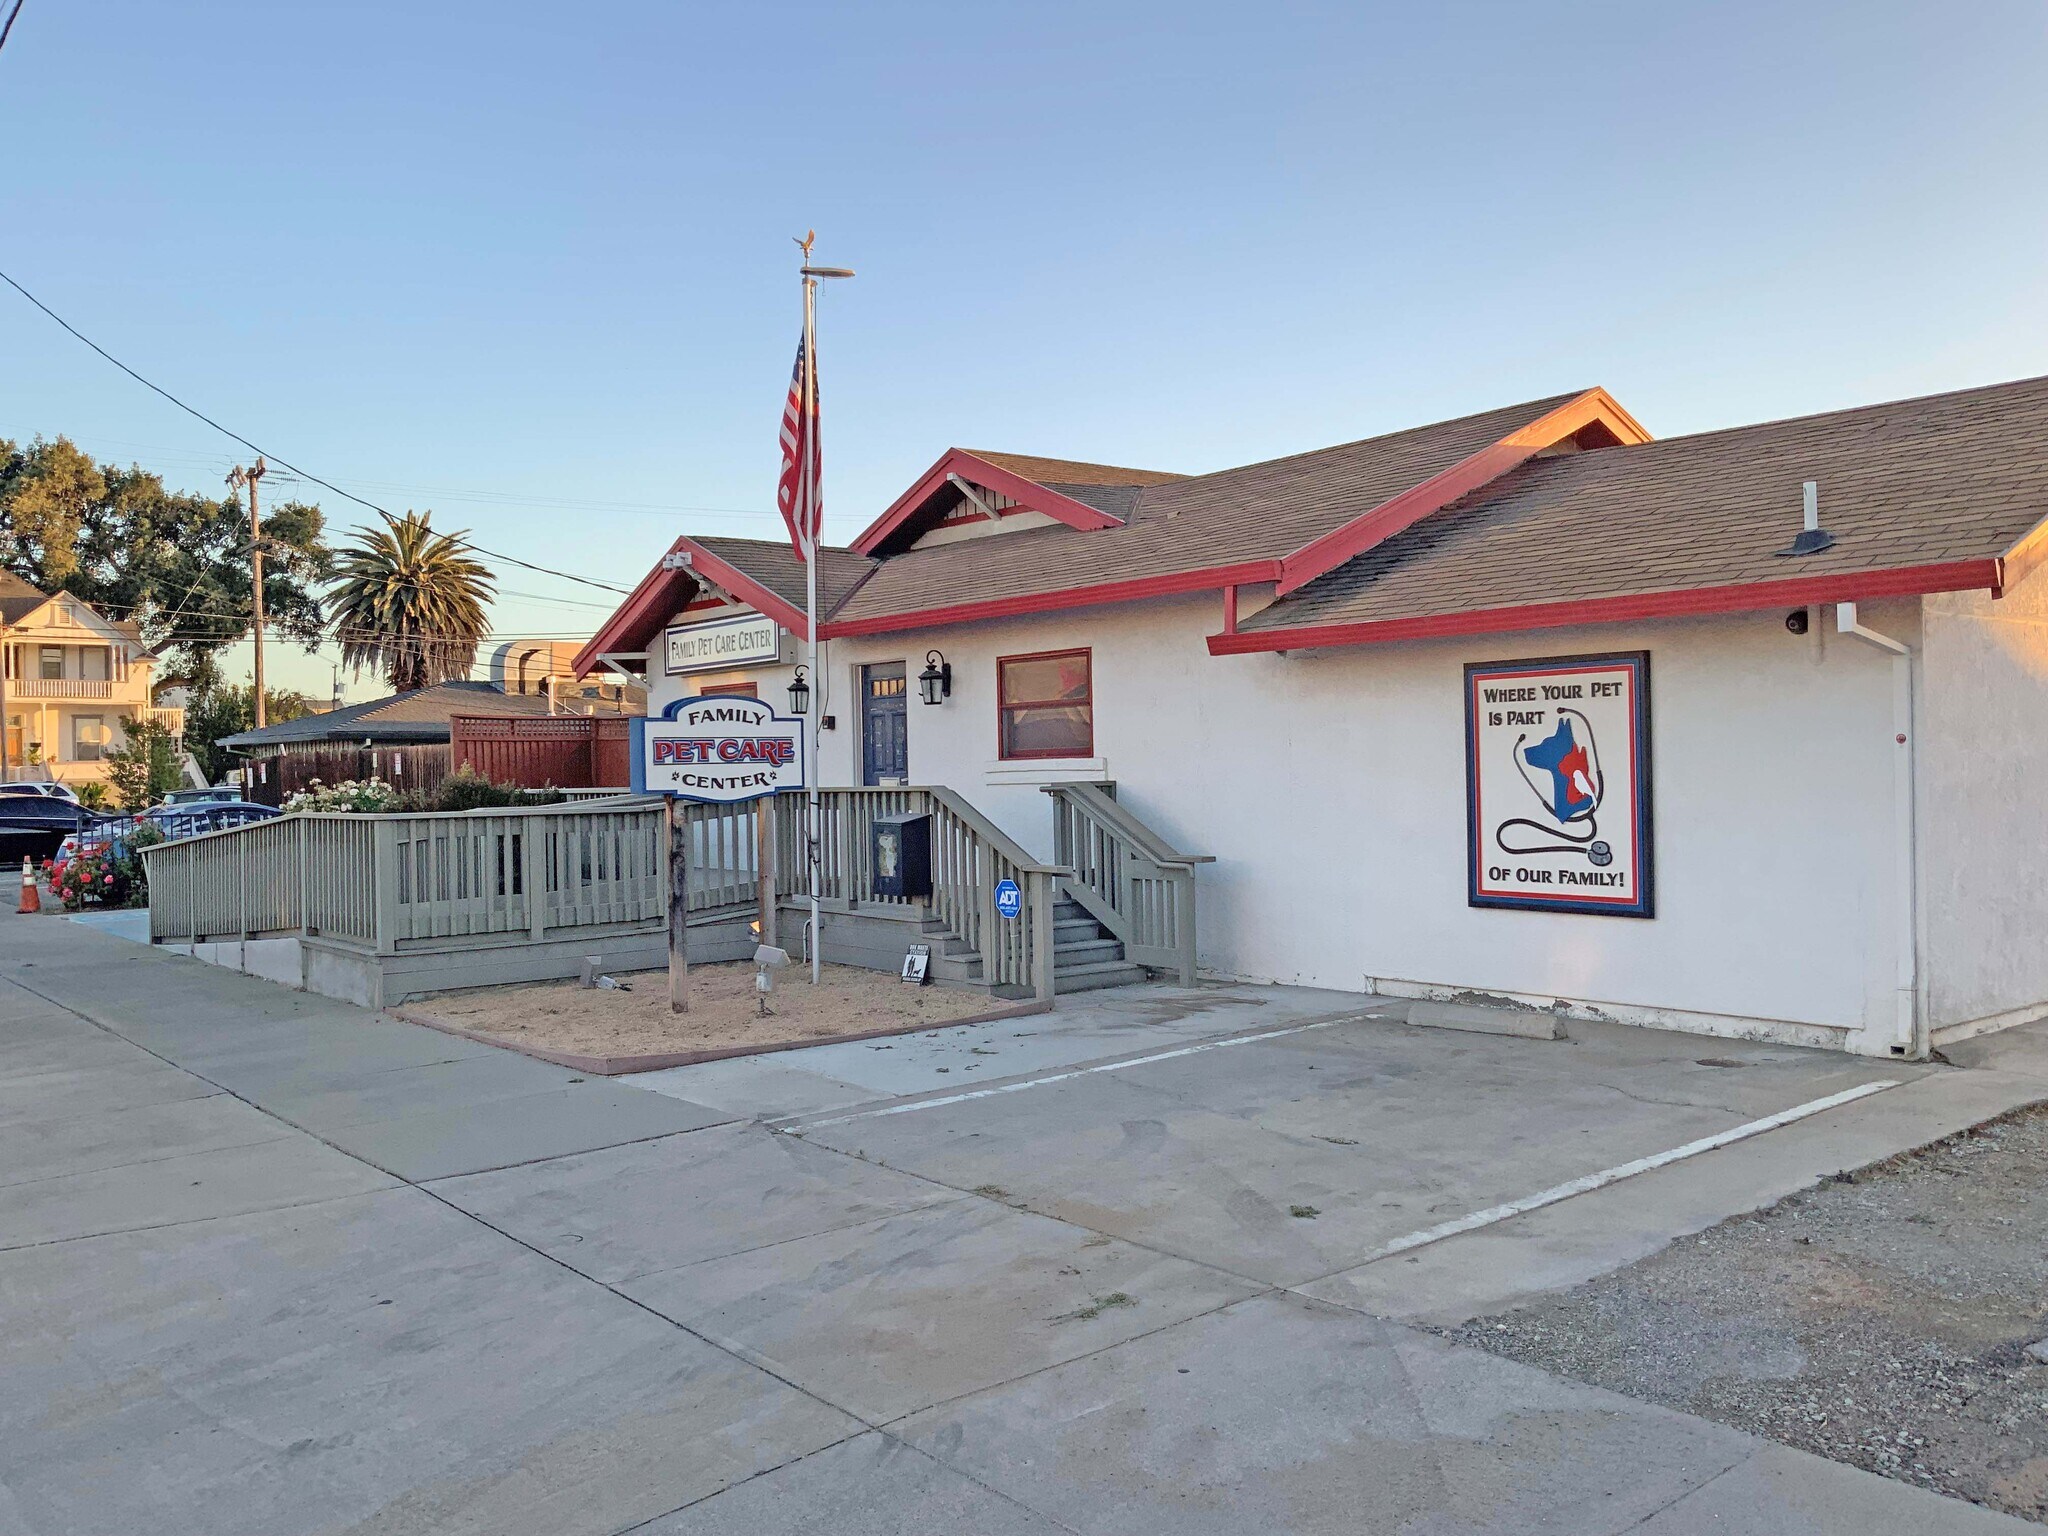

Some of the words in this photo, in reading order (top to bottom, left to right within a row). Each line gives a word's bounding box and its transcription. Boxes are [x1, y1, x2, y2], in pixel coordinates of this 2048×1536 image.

[671, 639, 697, 660] FAMILY
[698, 637, 713, 657] PET
[715, 634, 736, 654] CARE
[738, 629, 771, 651] CENTER
[1484, 687, 1536, 703] WHERE
[1541, 684, 1583, 700] YOUR
[1591, 681, 1623, 697] PET
[688, 708, 766, 726] FAMILY
[1488, 711, 1503, 726] IS
[1506, 710, 1545, 726] PART
[653, 738, 715, 763] PET
[717, 738, 795, 767] CARE
[681, 771, 771, 790] CENTER
[1488, 866, 1511, 882] OF
[1516, 868, 1553, 884] OUR
[1558, 869, 1625, 888] FAMILY!
[999, 890, 1018, 906] ADT
